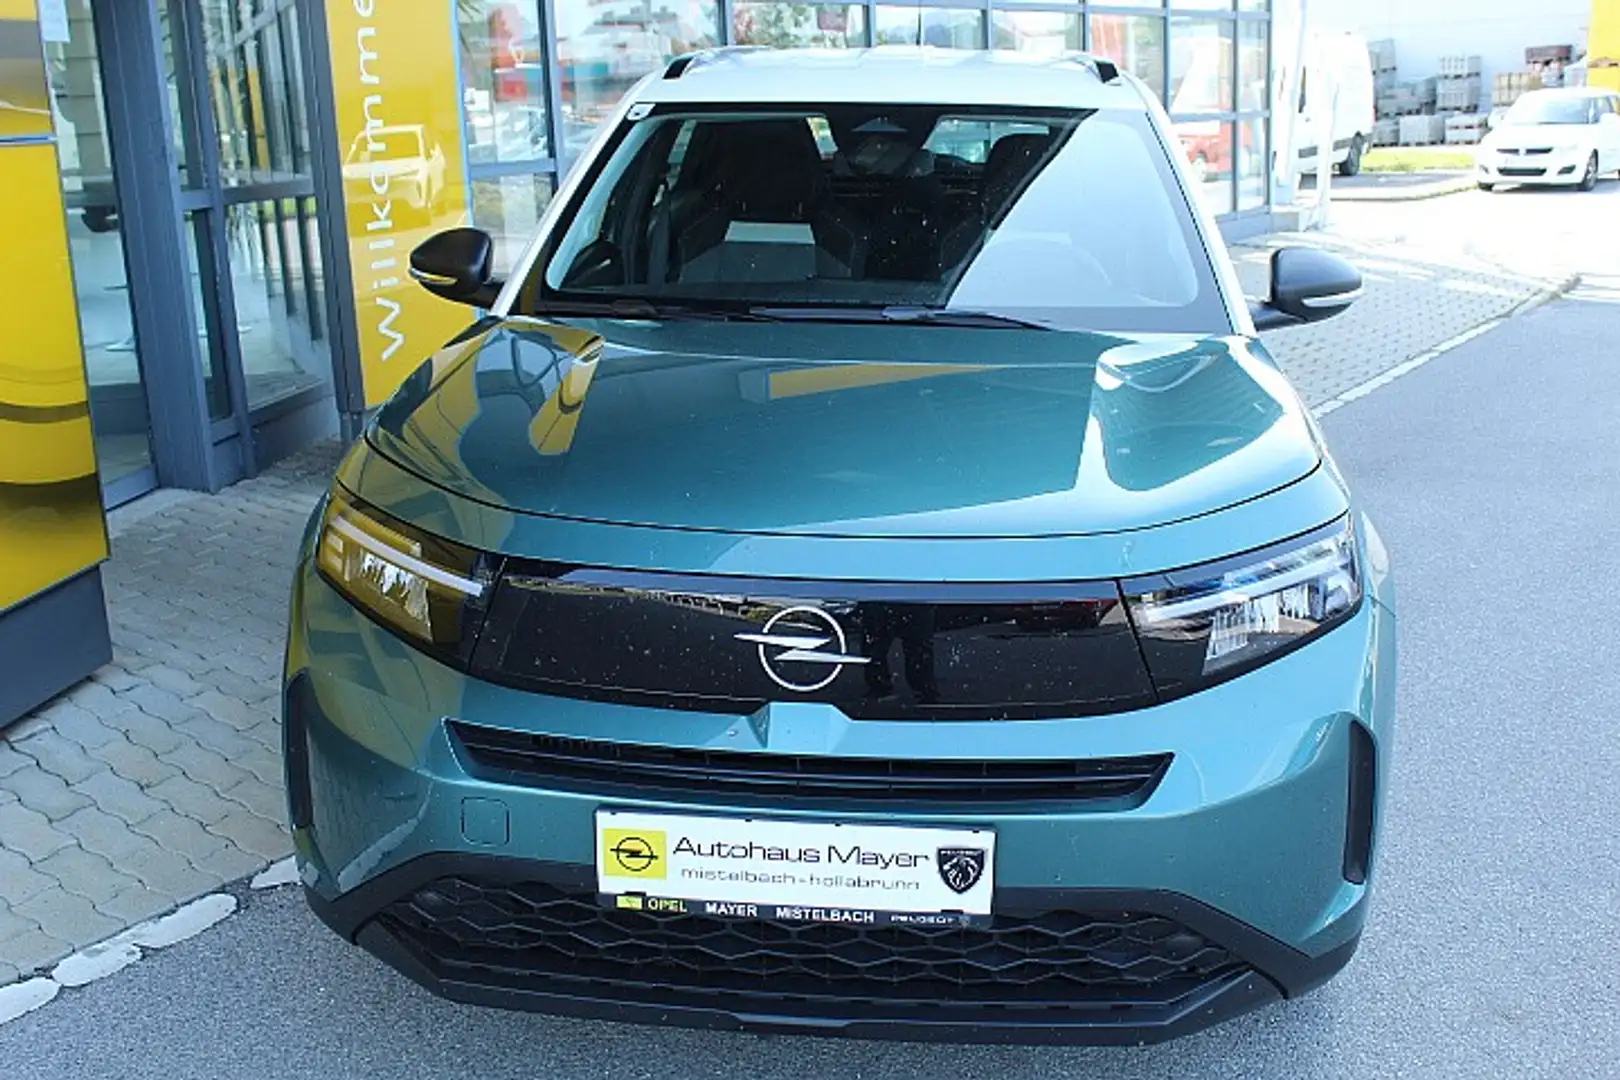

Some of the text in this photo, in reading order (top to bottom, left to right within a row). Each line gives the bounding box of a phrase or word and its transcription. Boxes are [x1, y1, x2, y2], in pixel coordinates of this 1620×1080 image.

[673, 837, 929, 870] Autohaus Mayer
[648, 898, 687, 913] OPEL
[705, 902, 757, 917] MAYER
[776, 906, 874, 923] MISTELBACH
